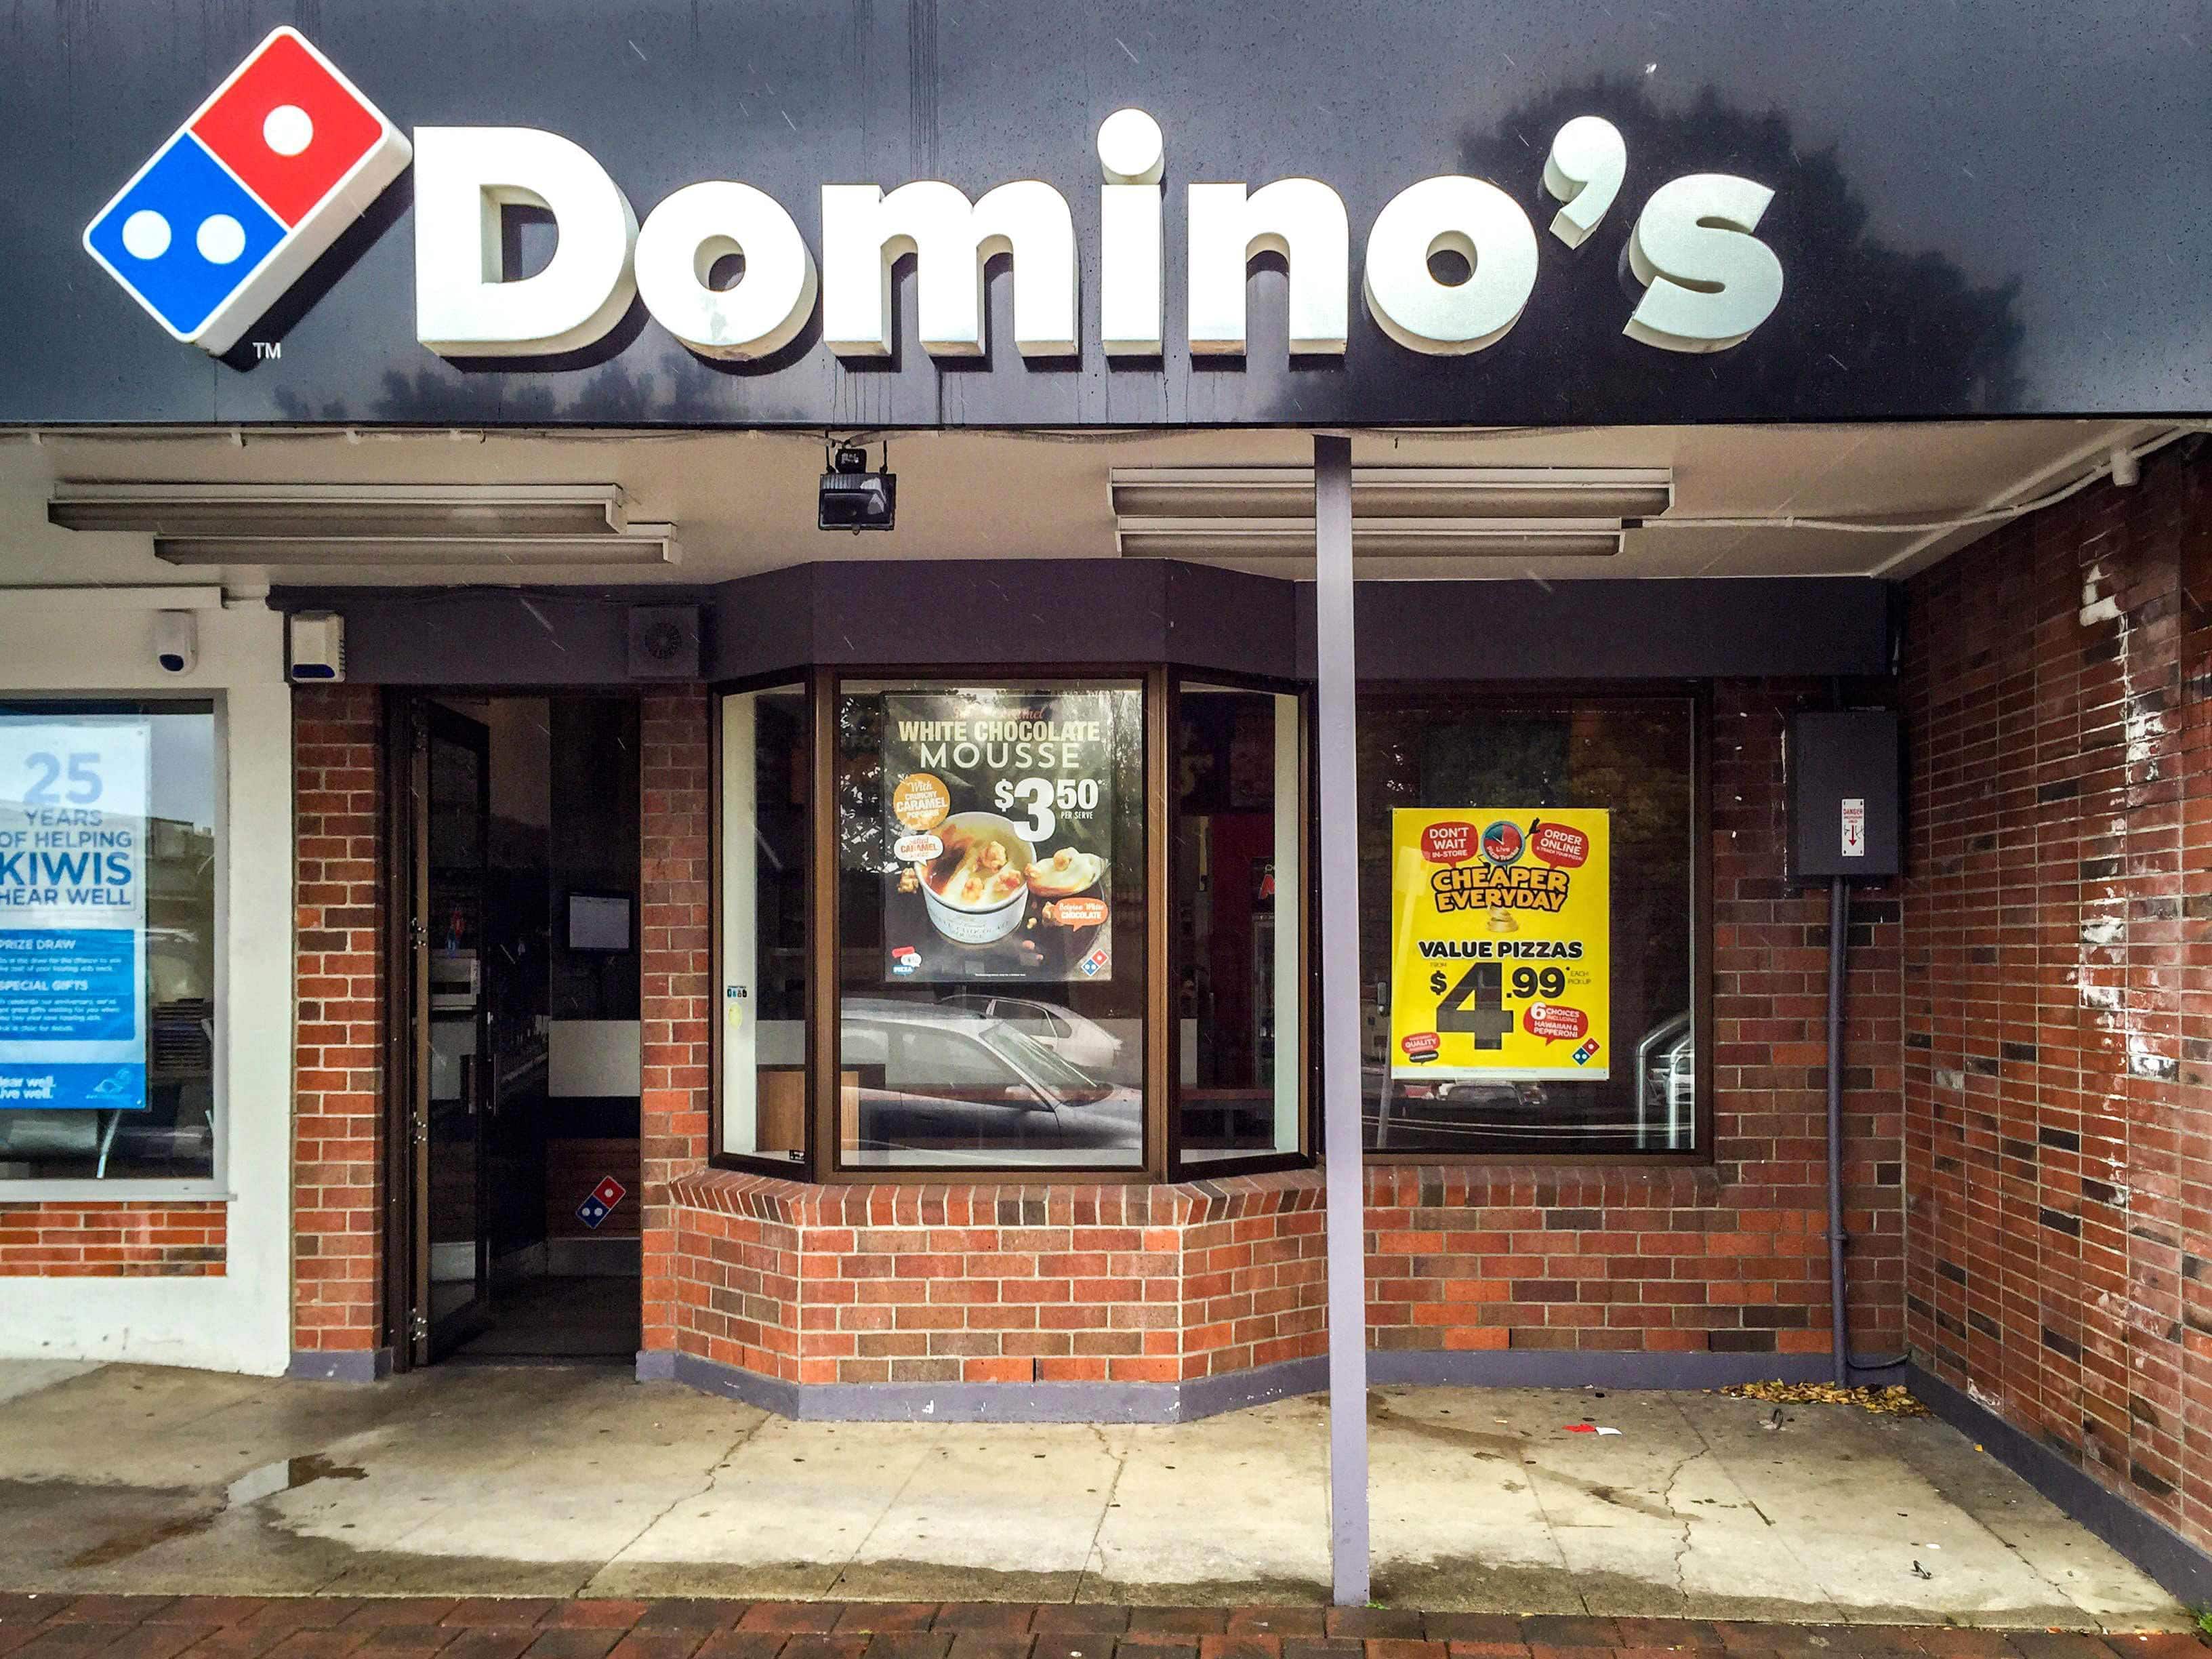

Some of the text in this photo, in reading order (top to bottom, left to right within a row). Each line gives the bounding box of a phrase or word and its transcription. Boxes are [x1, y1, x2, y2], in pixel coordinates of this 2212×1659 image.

[413, 108, 1785, 356] Domino's
[252, 342, 281, 359] TM
[899, 720, 1100, 742] WHITE CHOCOLATE
[920, 742, 1080, 769] MOUSSE
[23, 752, 104, 805] 25
[896, 797, 948, 813] CARAMEL
[25, 809, 103, 827] YEARS
[1061, 811, 1093, 819] PER SERVE
[0, 831, 132, 848] OF HELPING
[1429, 827, 1469, 840] DON'T
[1544, 829, 1582, 846] ORDER
[900, 843, 939, 853] CARAMEL
[1433, 838, 1467, 850] WAIT
[1540, 838, 1582, 855] ONLINE
[1432, 849, 1468, 858] IN-STORE
[0, 851, 131, 886] KIWIS
[1431, 866, 1570, 893] CHEAPER
[0, 888, 131, 905] HEAR WELL
[1435, 888, 1568, 912] EVERYDAY
[1061, 911, 1102, 920] CHOCOLATE
[36, 939, 77, 949] DRAW
[1418, 941, 1583, 959] VALUE PIZZAS
[52, 980, 88, 991] GIFTS
[1530, 1002, 1580, 1020] 6 CHOICES
[1534, 1020, 1572, 1031] HAWAIIAN
[1534, 1027, 1578, 1038] PEPPERONI
[1404, 1038, 1437, 1049] QUALITY
